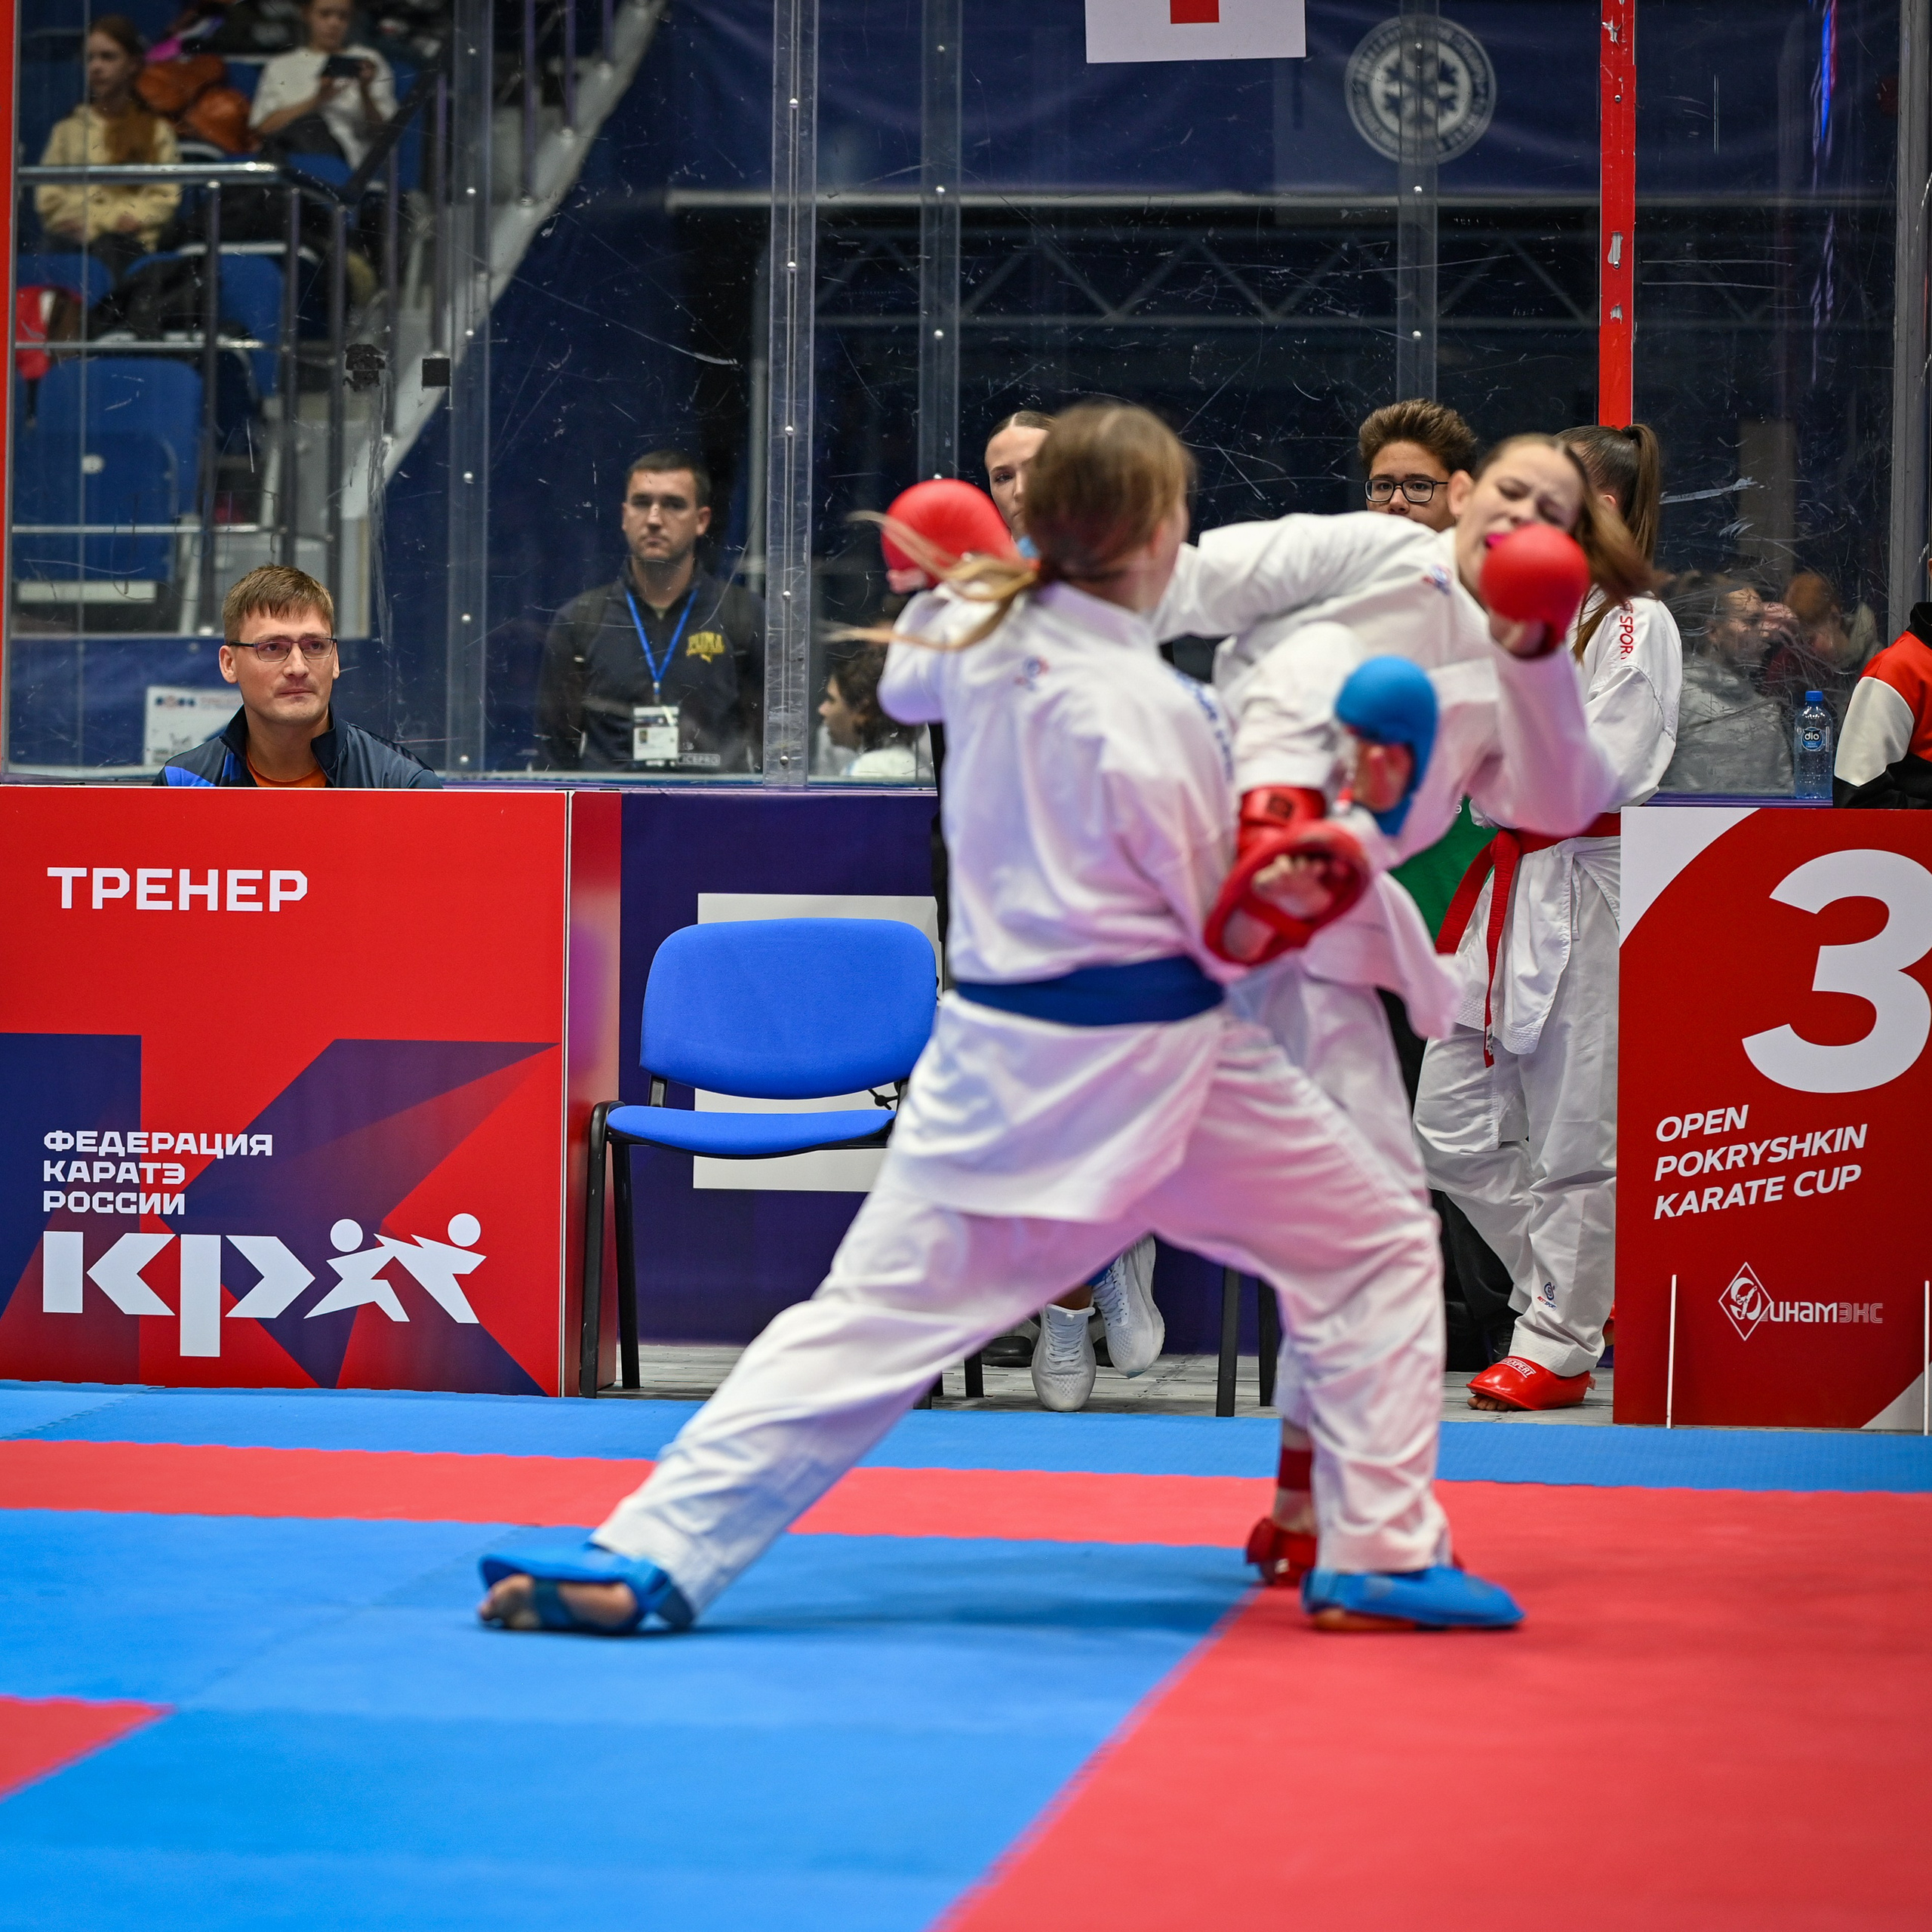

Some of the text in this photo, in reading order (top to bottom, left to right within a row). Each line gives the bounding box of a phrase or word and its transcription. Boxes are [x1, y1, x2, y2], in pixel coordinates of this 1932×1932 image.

[47, 866, 308, 912] ТРЕНЕР
[1742, 849, 1932, 1094] 3
[1657, 1105, 1749, 1142] OPEN
[44, 1130, 273, 1159] ФЕДЕРАЦИЯ
[1655, 1124, 1868, 1181] POKRYSHKIN
[44, 1160, 185, 1184] КАРАТЭ
[1654, 1164, 1862, 1220] KARATE CUP
[44, 1190, 185, 1215] РОССИИ
